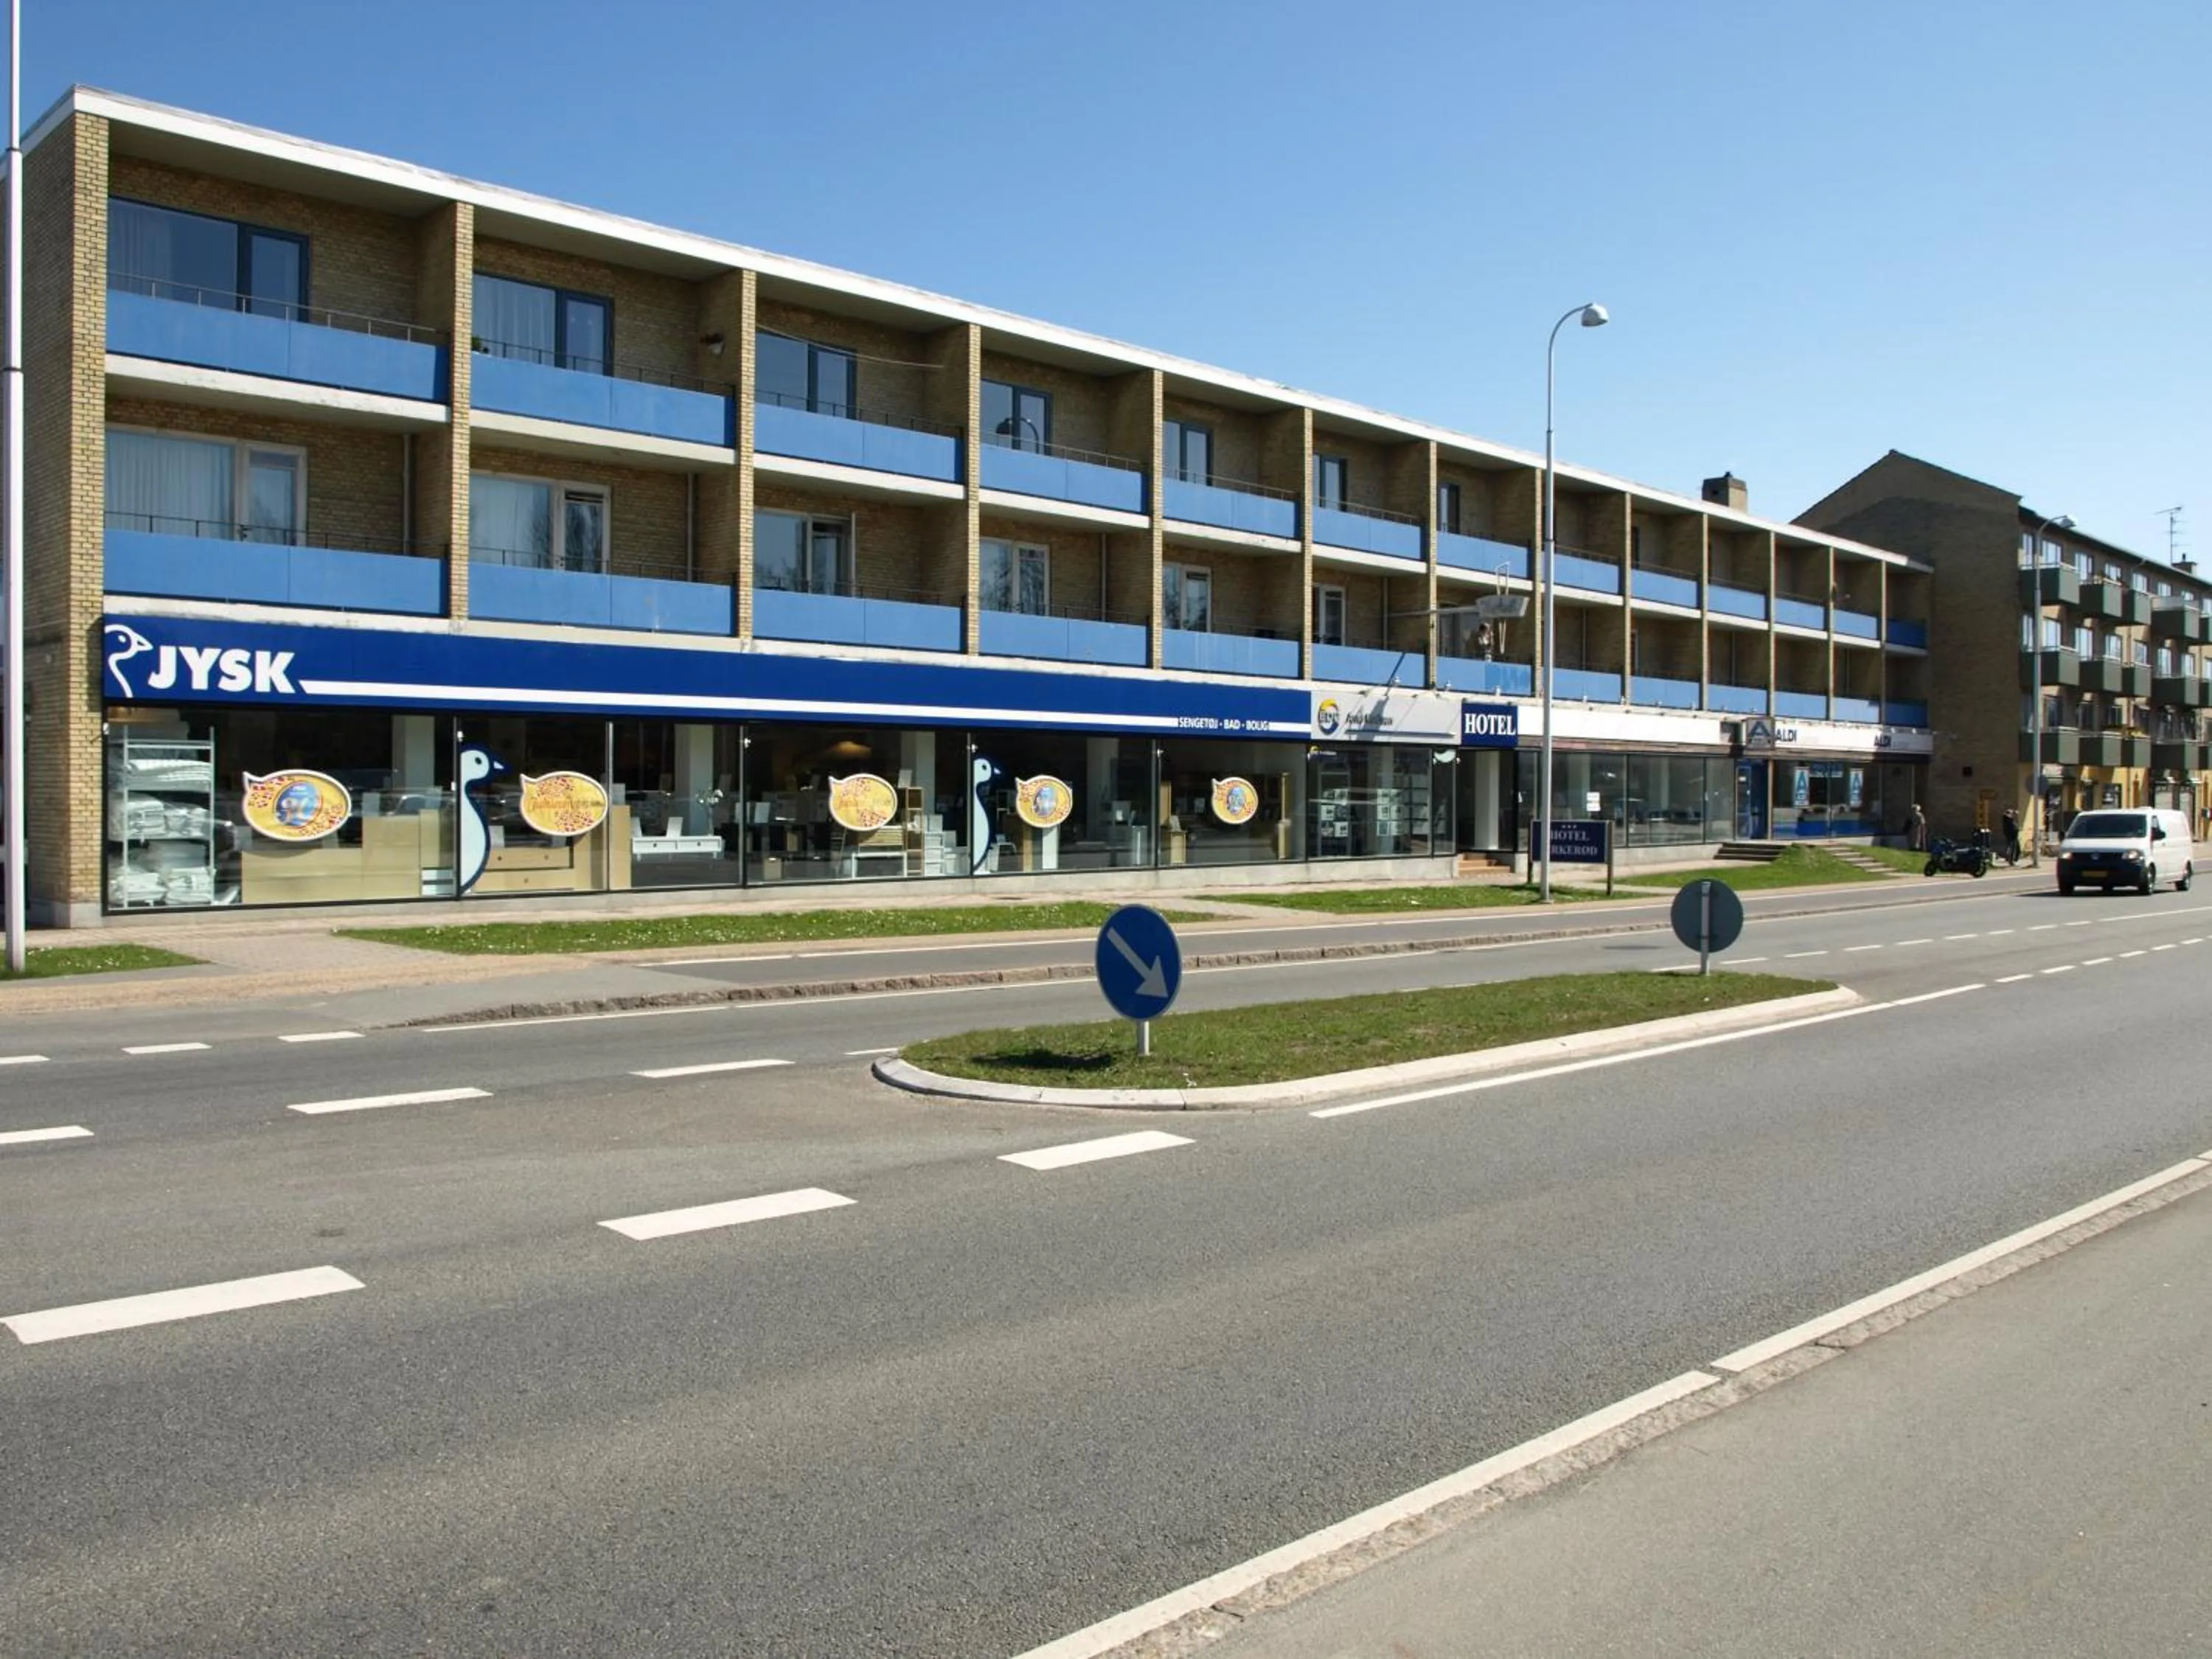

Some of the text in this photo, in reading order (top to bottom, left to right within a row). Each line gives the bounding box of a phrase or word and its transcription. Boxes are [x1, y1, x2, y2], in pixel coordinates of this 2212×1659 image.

[147, 645, 296, 694] JYSK
[1223, 719, 1241, 729] BAD
[1464, 713, 1516, 734] HOTEL
[1775, 728, 1797, 743] ALDI
